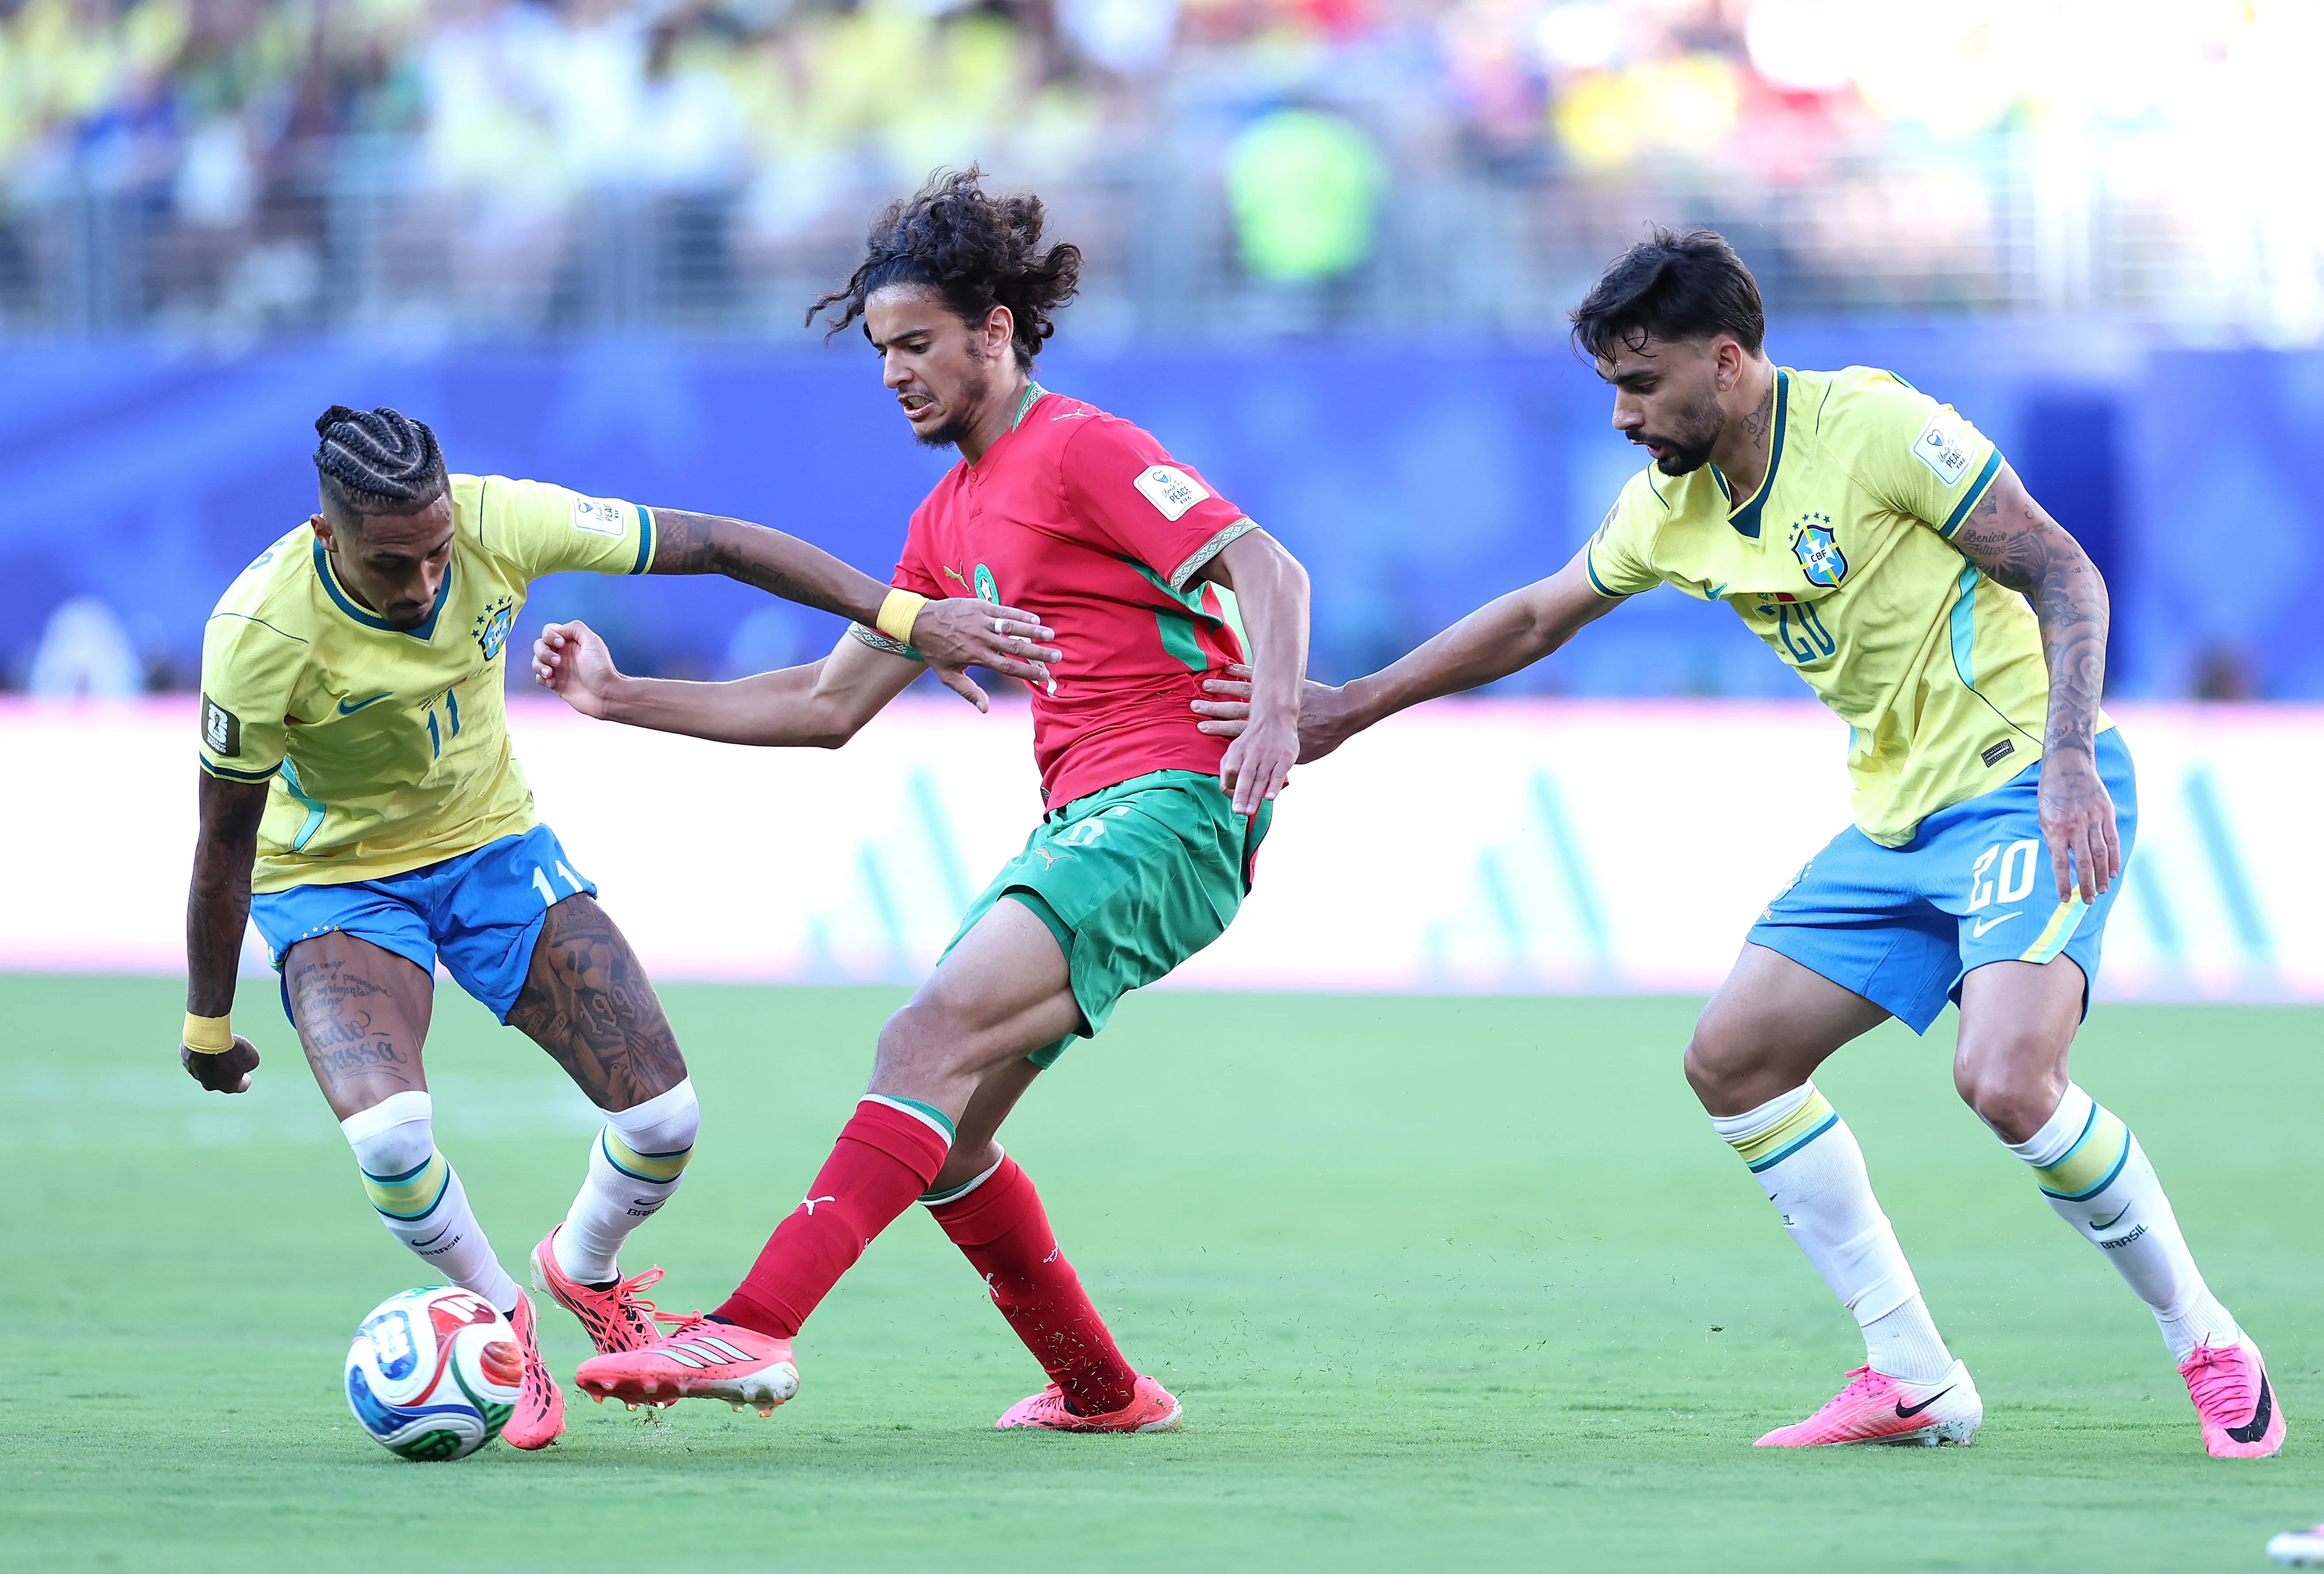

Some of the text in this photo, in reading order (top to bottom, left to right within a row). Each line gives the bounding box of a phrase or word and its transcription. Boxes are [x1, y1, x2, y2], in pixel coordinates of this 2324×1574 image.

[1946, 446, 1963, 468] PEACE
[1957, 458, 1965, 469] FIFA
[1170, 486, 1191, 503] PEACE
[1811, 549, 1827, 562] CBF
[492, 625, 503, 641] CBF
[426, 688, 460, 761] 11
[531, 860, 584, 908] 11
[1964, 839, 2040, 914] 20
[418, 1233, 463, 1256] BRASIL
[2099, 1224, 2148, 1249] BRASIL
